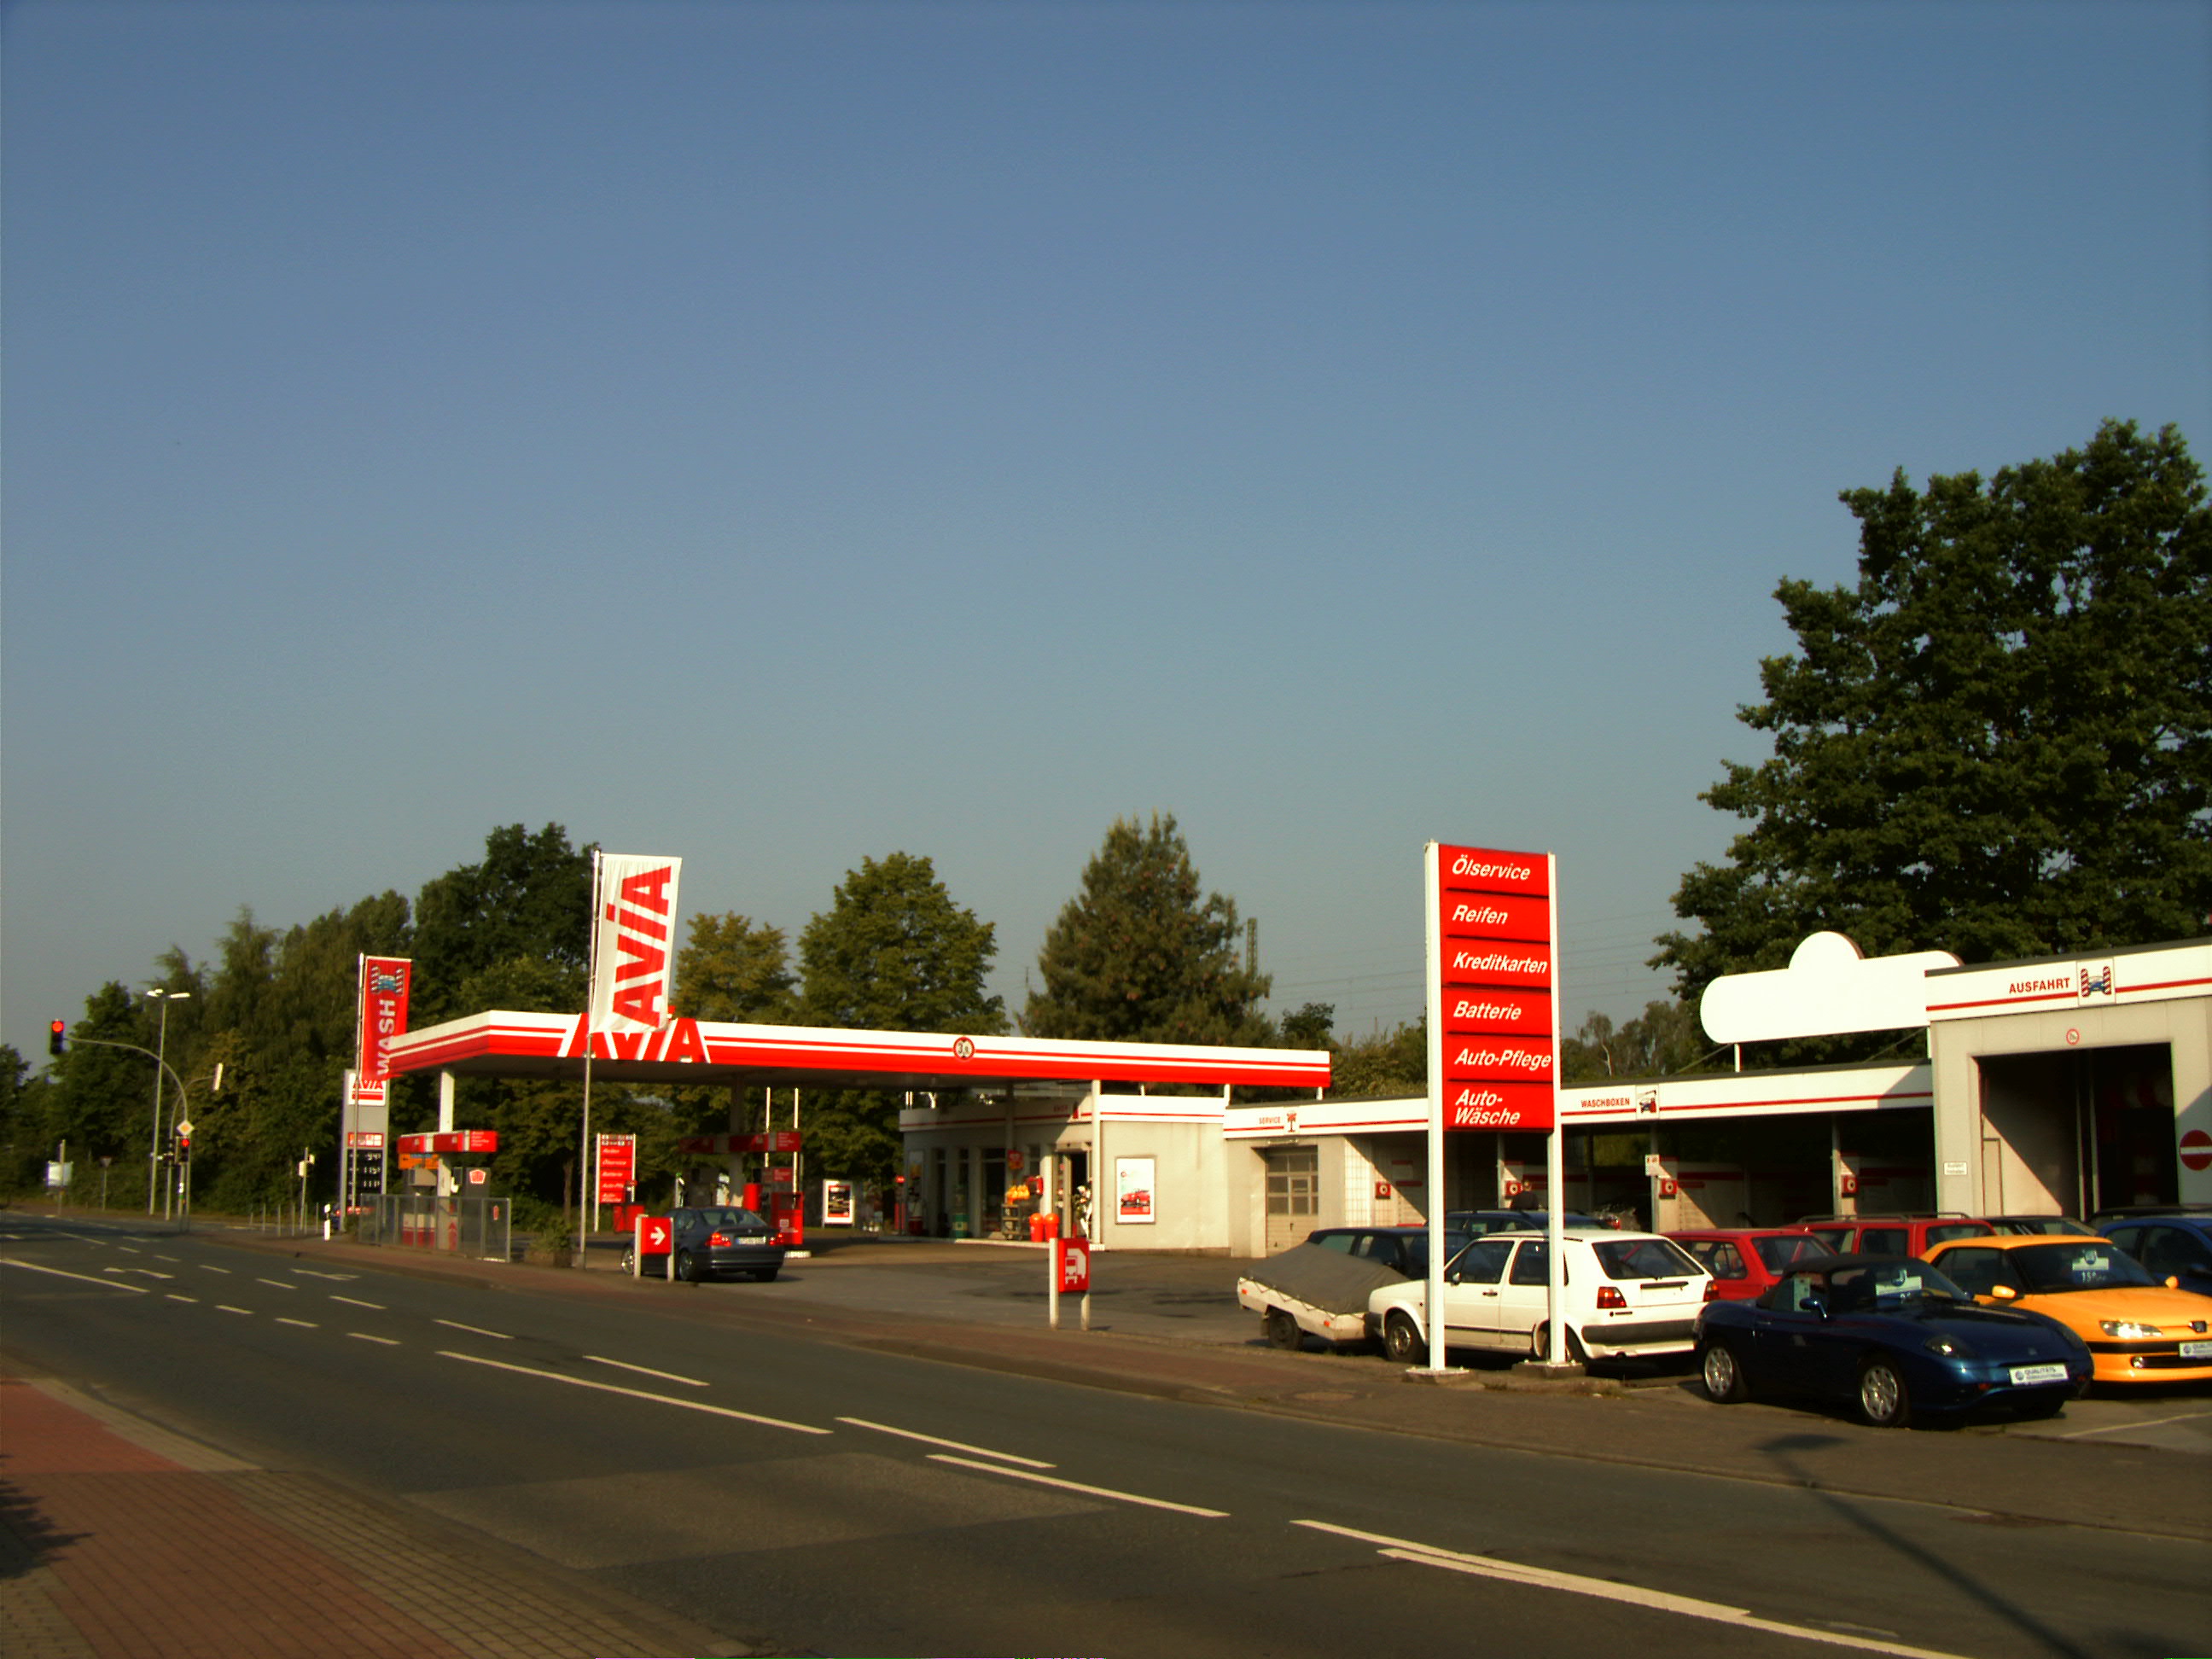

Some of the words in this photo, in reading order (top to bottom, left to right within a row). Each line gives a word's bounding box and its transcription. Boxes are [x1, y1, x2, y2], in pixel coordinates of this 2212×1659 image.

[1452, 853, 1531, 880] Ölservice
[1452, 905, 1508, 925] Reifen
[606, 865, 672, 1029] AVIA
[1452, 952, 1548, 974] Kreditkarten
[2009, 977, 2070, 994] AUSFAHRT
[1453, 1000, 1522, 1021] Batterie
[376, 999, 396, 1075] WASH
[1454, 1048, 1551, 1071] Auto-Pflege
[1455, 1088, 1503, 1107] Auto-
[1581, 1097, 1630, 1108] WASCHBOXEN
[1454, 1107, 1521, 1125] Wäsche
